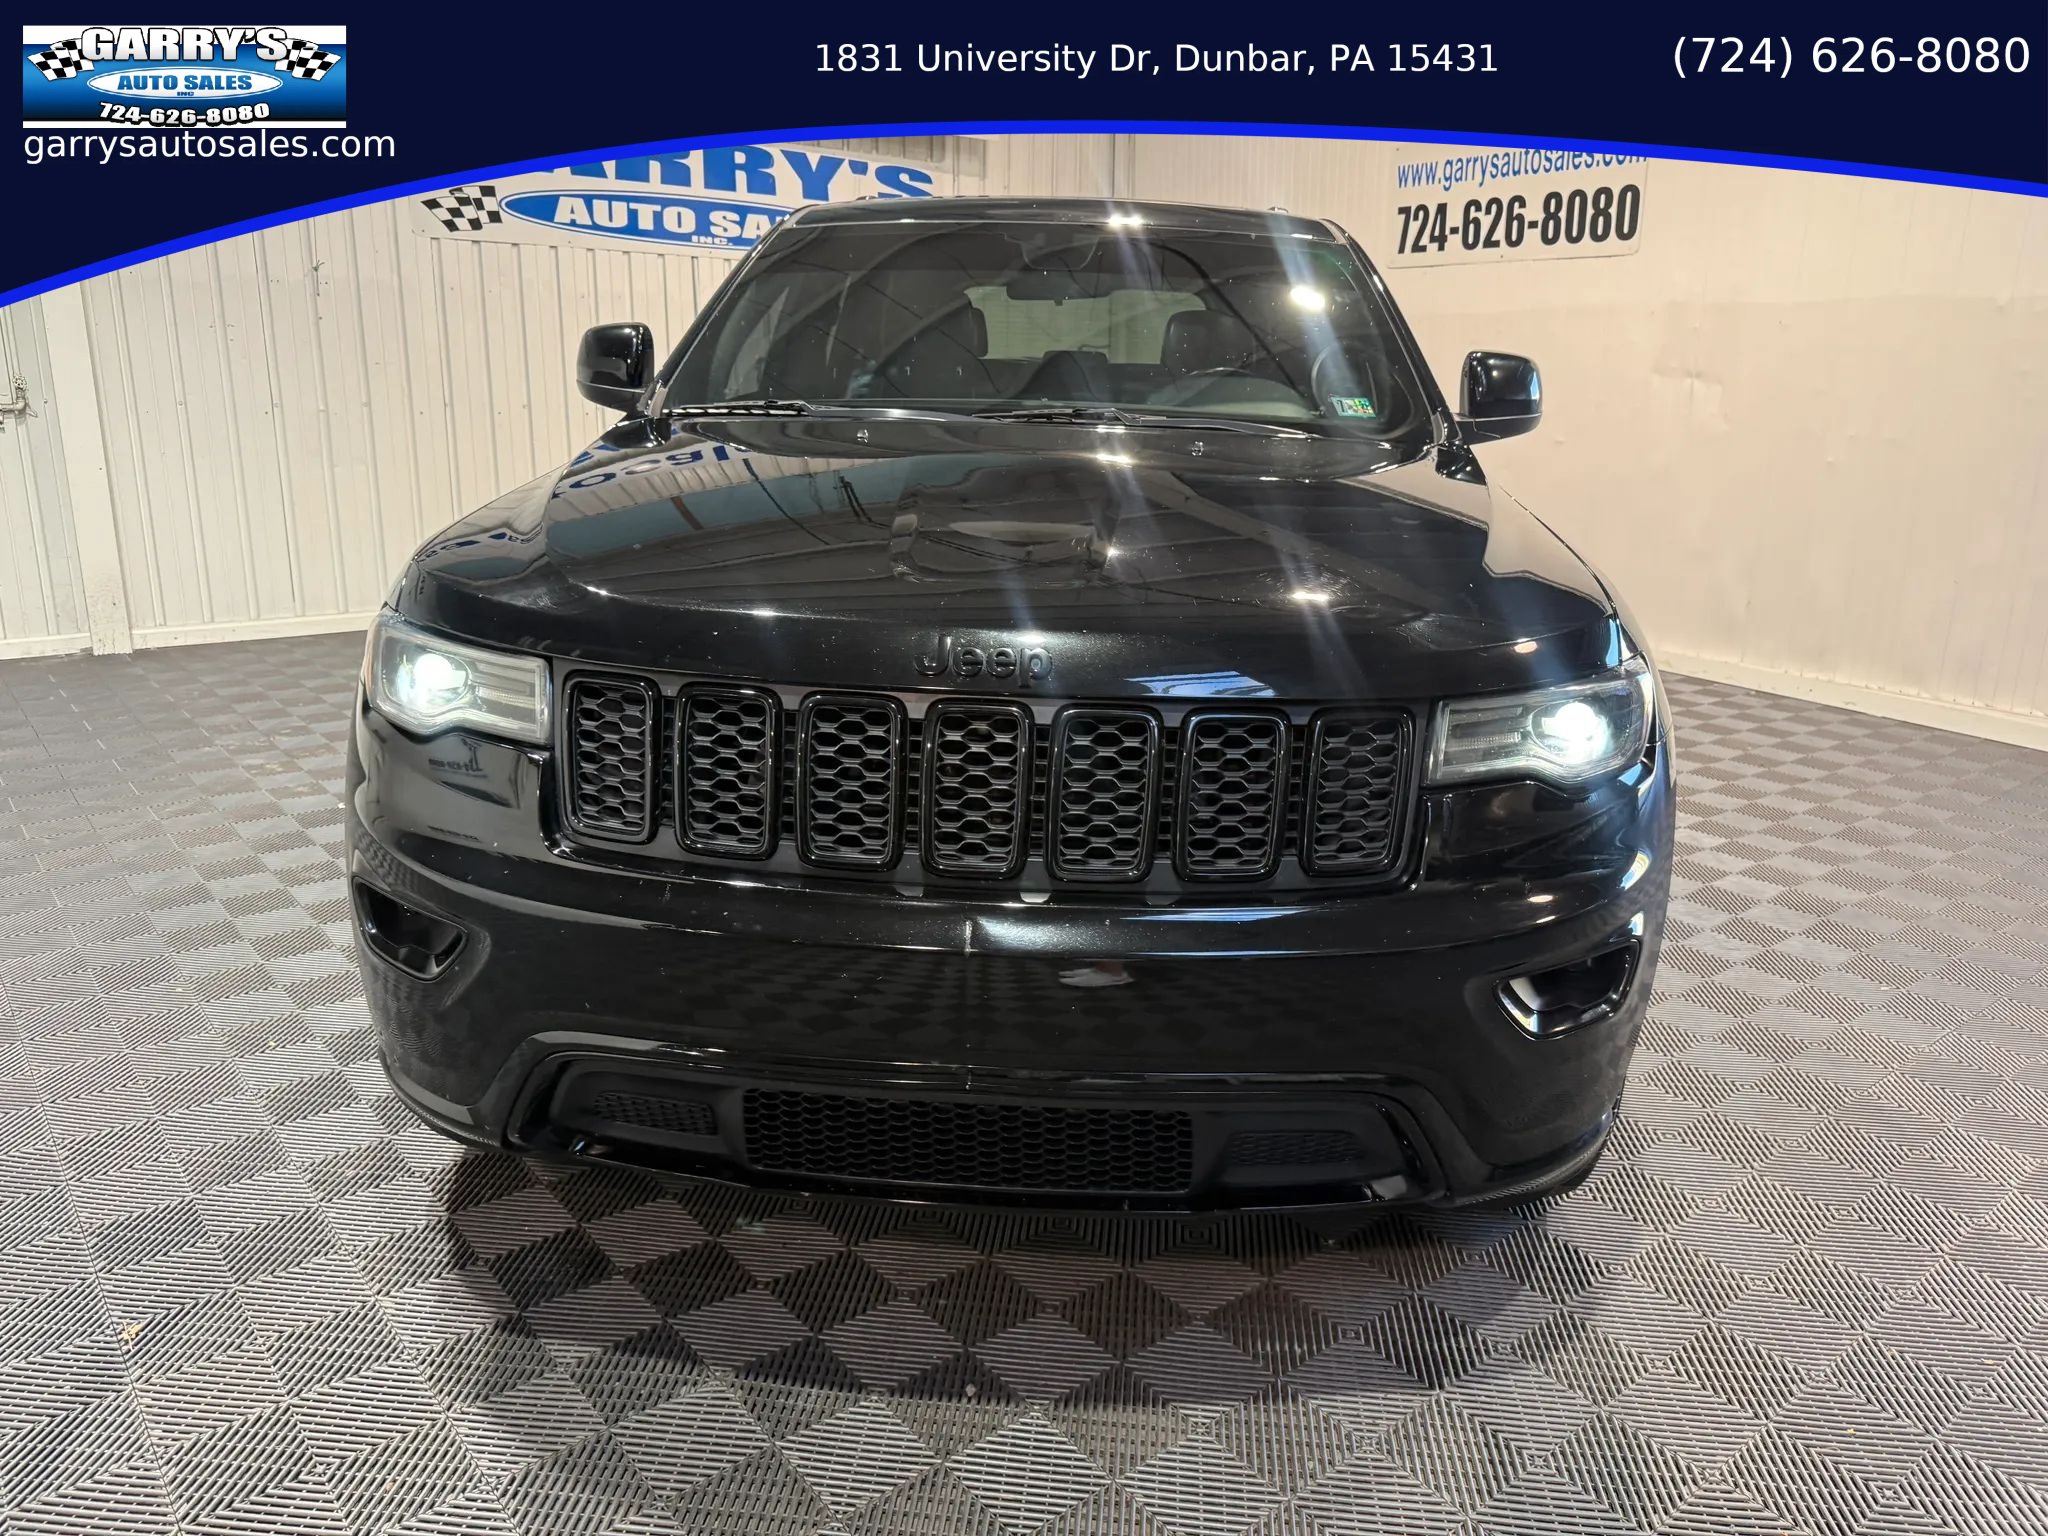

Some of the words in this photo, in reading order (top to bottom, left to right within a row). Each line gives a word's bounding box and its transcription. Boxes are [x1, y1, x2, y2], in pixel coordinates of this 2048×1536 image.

[1397, 148, 1647, 192] www.garrysautosales.
[553, 196, 697, 235] AUTO
[1397, 183, 1641, 255] 724-626-8080
[912, 633, 1053, 688] Jeep
